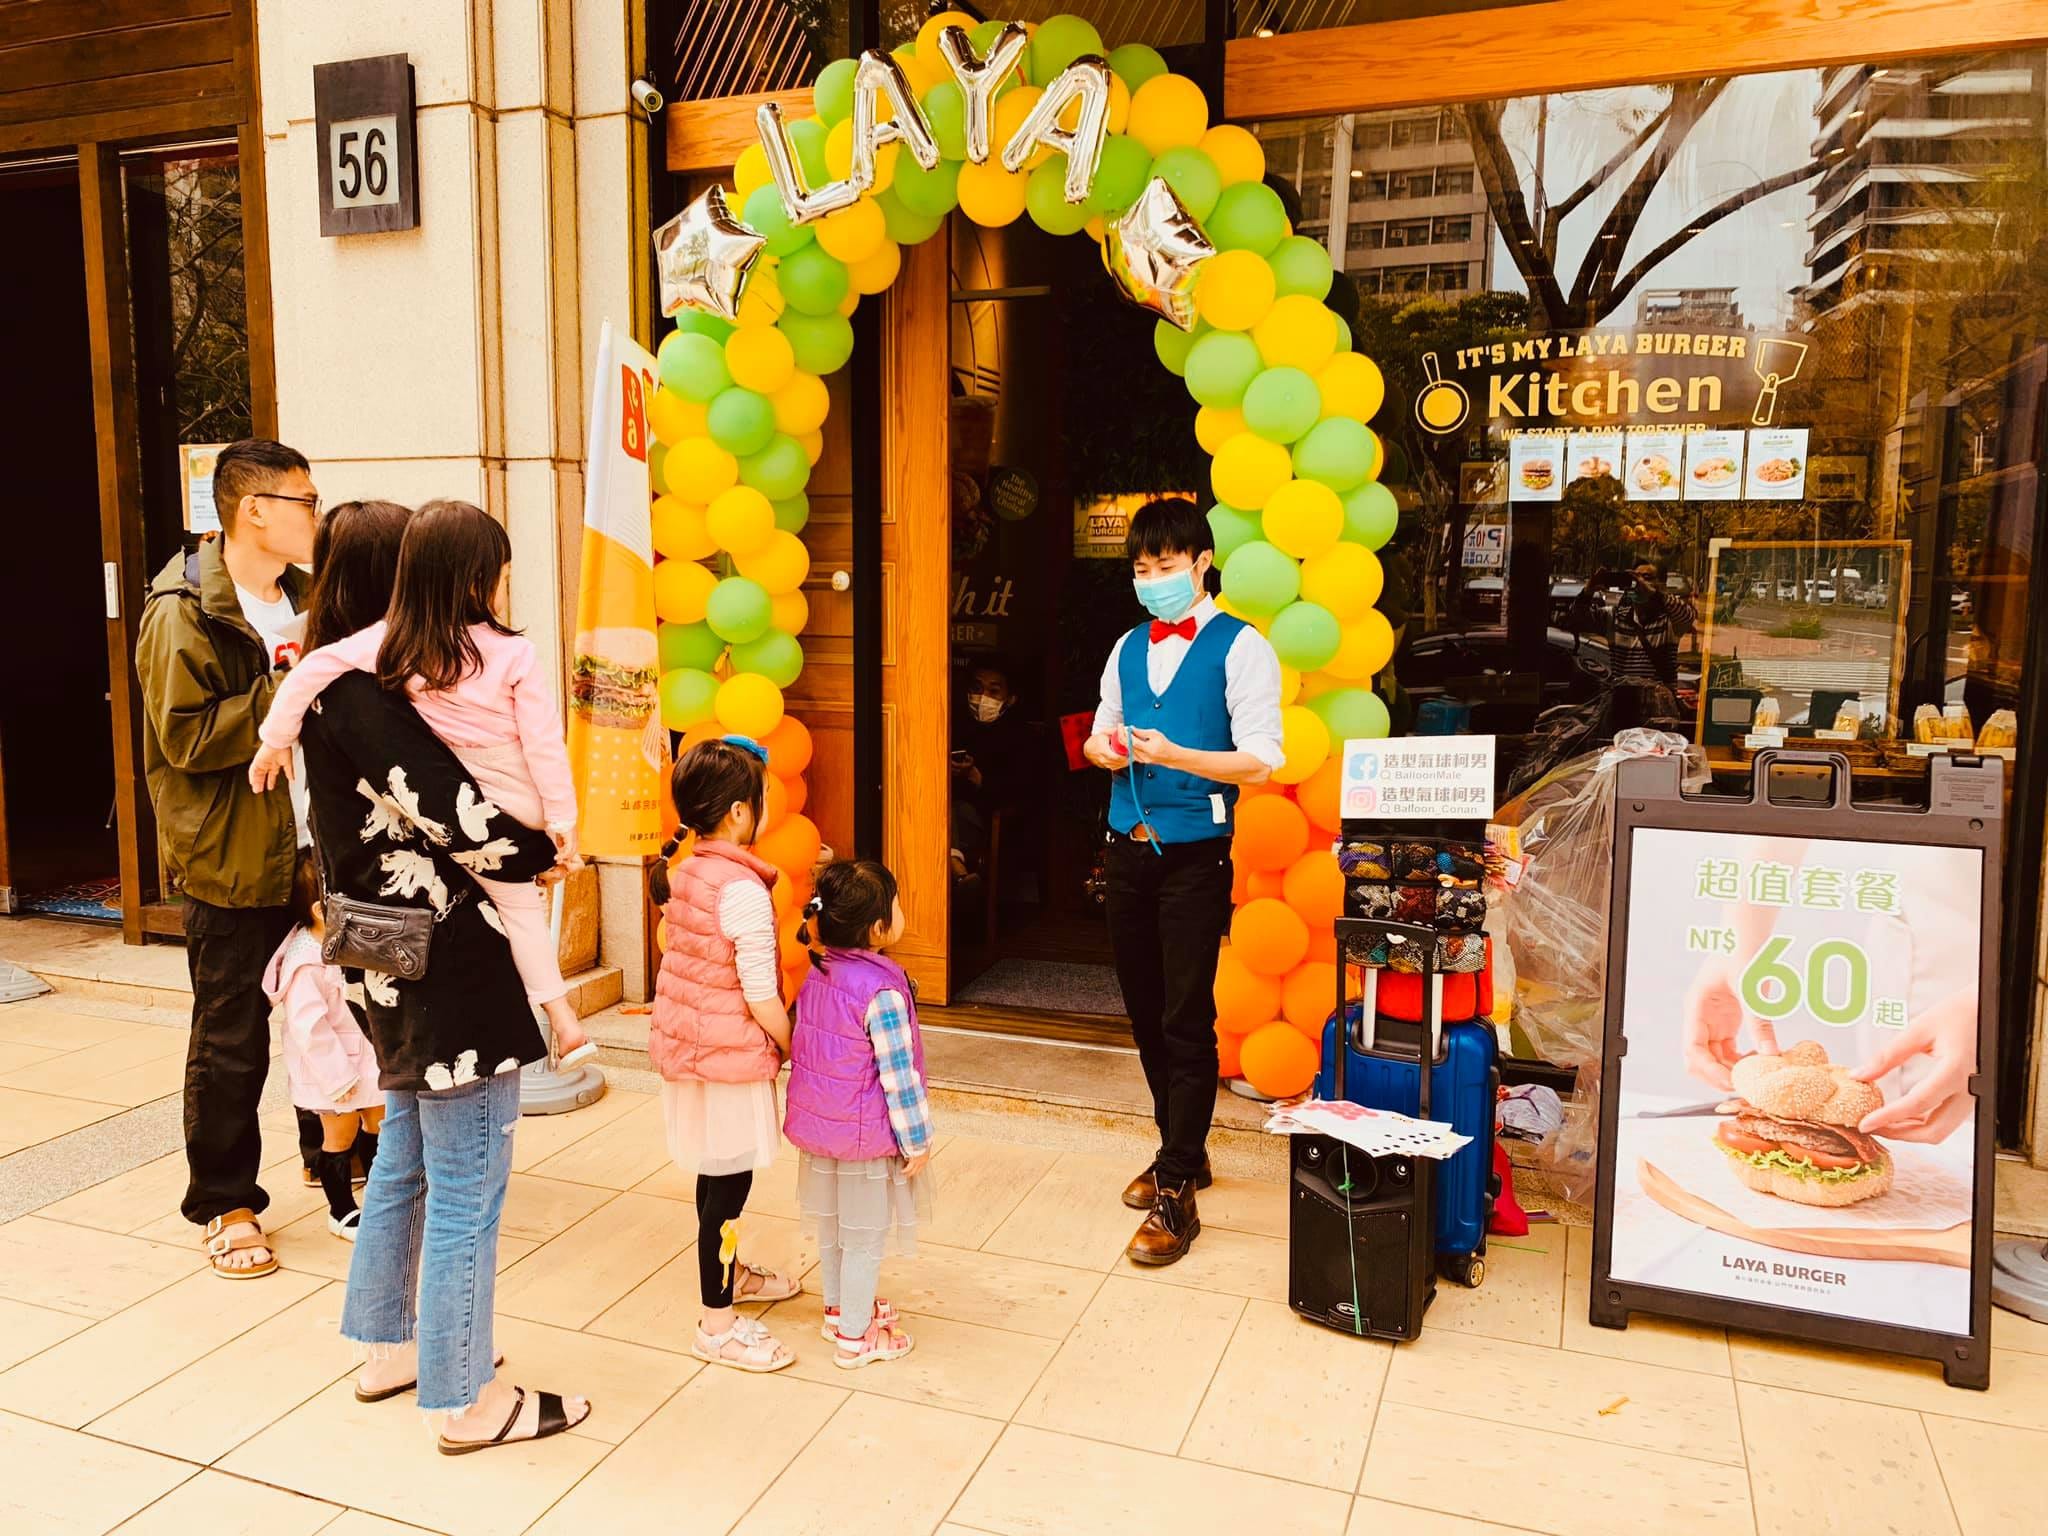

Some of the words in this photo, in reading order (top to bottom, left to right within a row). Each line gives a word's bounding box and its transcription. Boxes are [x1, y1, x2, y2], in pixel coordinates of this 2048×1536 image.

[755, 20, 1112, 225] LAYA
[339, 128, 388, 199] 56
[1457, 342, 1506, 369] IT'S
[1511, 338, 1552, 361] MY
[1559, 334, 1629, 357] LAYA
[1636, 333, 1747, 359] BURGER
[1488, 369, 1723, 419] Kitchen
[1090, 517, 1124, 528] LAYA
[1090, 528, 1124, 536] BURGER
[1383, 752, 1488, 769] 造型氣球柯男
[1382, 786, 1486, 803] 造型氣球柯男
[1697, 859, 1900, 911] 超值套餐
[1689, 927, 1736, 953] NT$
[1741, 936, 1869, 1024] 60
[1875, 1000, 1905, 1027] 起
[1722, 1255, 1769, 1274] LAYA
[1772, 1263, 1847, 1286] BURGER
